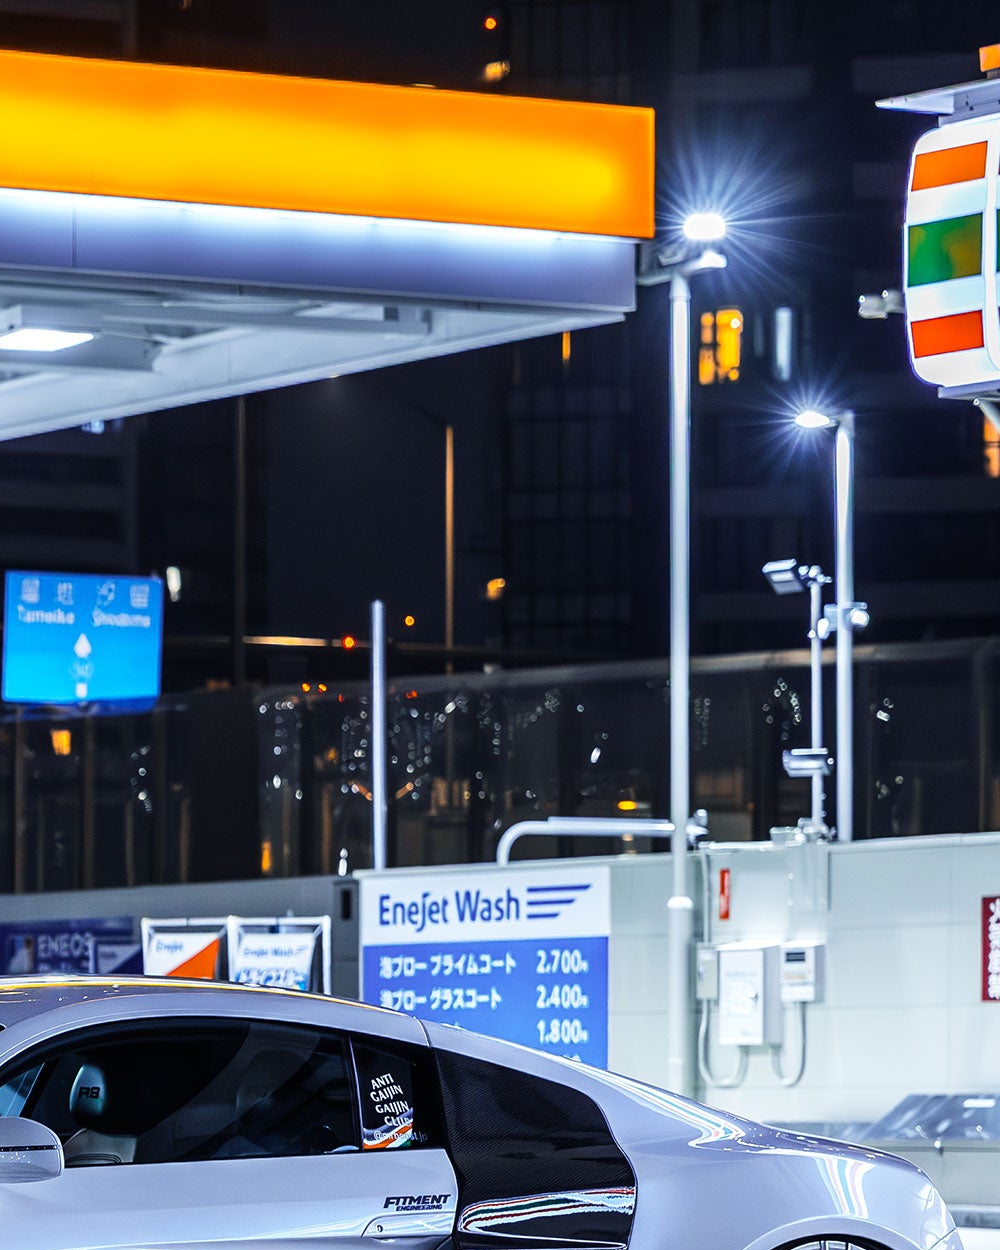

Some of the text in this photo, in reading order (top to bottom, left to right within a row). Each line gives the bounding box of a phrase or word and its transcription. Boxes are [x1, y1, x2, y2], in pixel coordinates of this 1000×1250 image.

[455, 888, 520, 922] Wash
[371, 1073, 394, 1089] ANTI
[78, 1087, 100, 1099] R8
[370, 1085, 403, 1102] GAIJIN
[375, 1101, 409, 1115] GAIJIN
[383, 1194, 451, 1209] FITMENT
